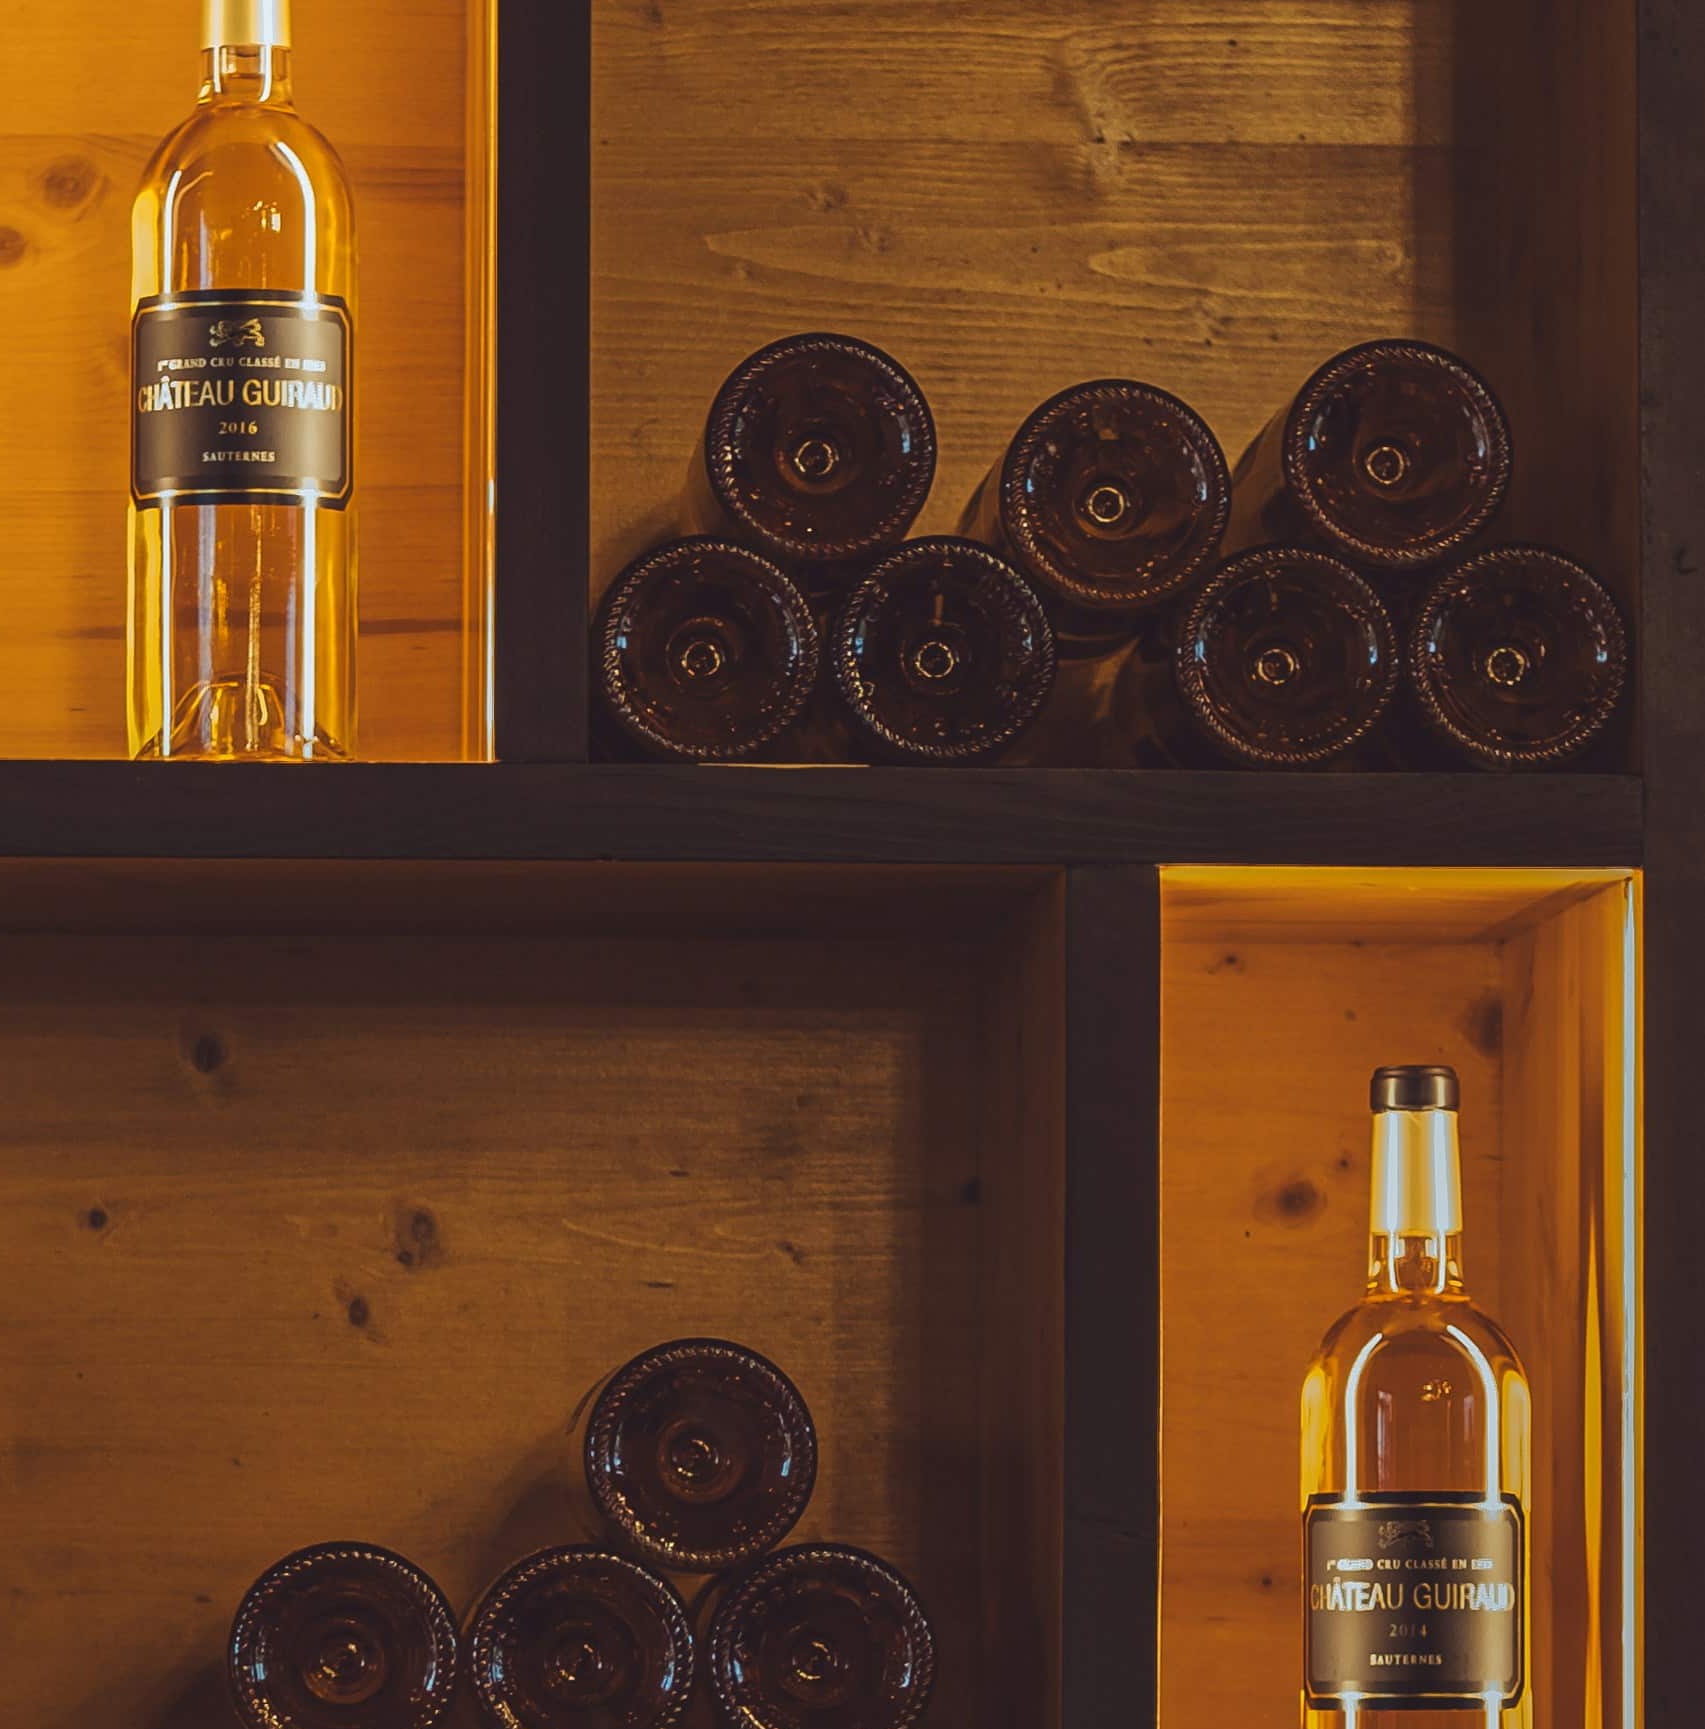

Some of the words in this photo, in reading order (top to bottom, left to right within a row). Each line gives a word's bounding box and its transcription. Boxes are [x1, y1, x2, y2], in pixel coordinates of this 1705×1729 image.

[210, 356, 234, 367] CRU
[239, 355, 281, 368] CLASSÉ
[138, 375, 234, 413] CHÂTEAU
[242, 378, 343, 412] GUIRAUD
[218, 420, 258, 435] 2016
[202, 451, 275, 462] SAUTERNES
[1377, 1559, 1400, 1570] CRU
[1405, 1557, 1447, 1570] CLASSÉ
[1452, 1559, 1467, 1570] EN
[1310, 1576, 1404, 1612] CHÂTEAU
[1413, 1581, 1516, 1611] GUIRAUD
[1370, 1653, 1443, 1666] SAUTERNES
